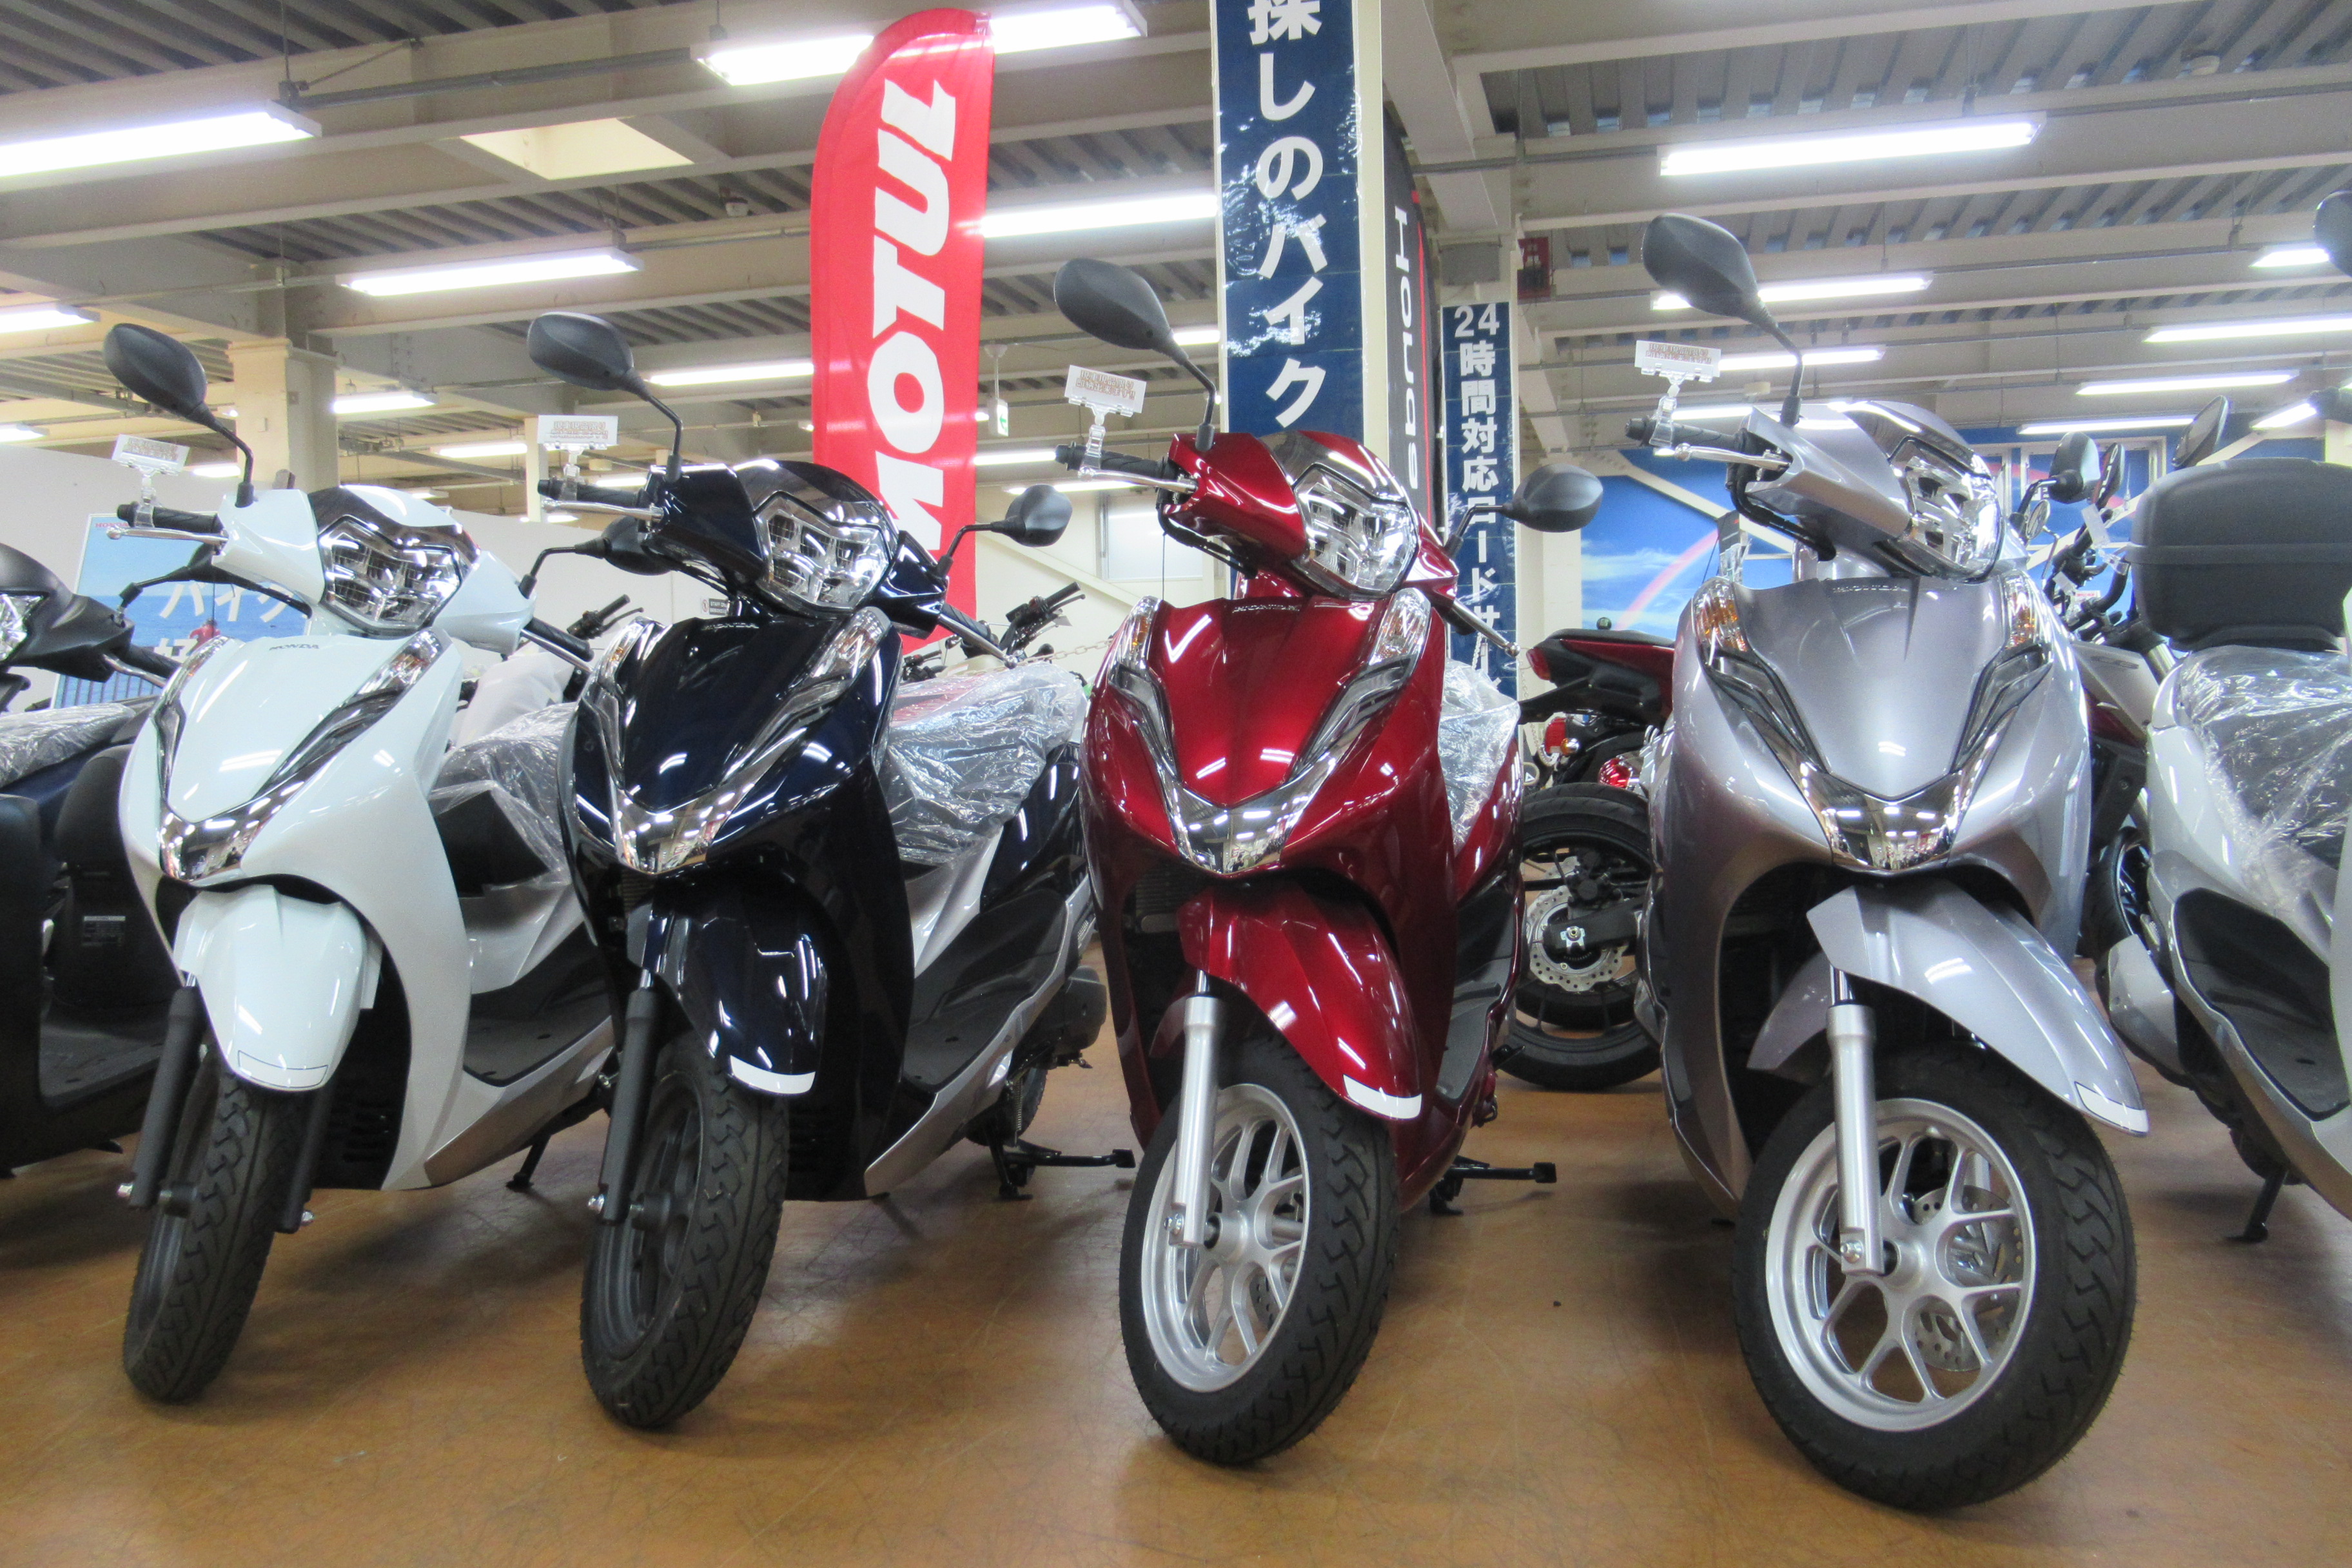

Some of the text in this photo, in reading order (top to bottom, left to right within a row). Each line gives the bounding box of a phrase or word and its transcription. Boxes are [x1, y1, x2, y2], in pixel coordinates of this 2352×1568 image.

[868, 78, 956, 551] MOTUL
[159, 582, 295, 623] バイク
